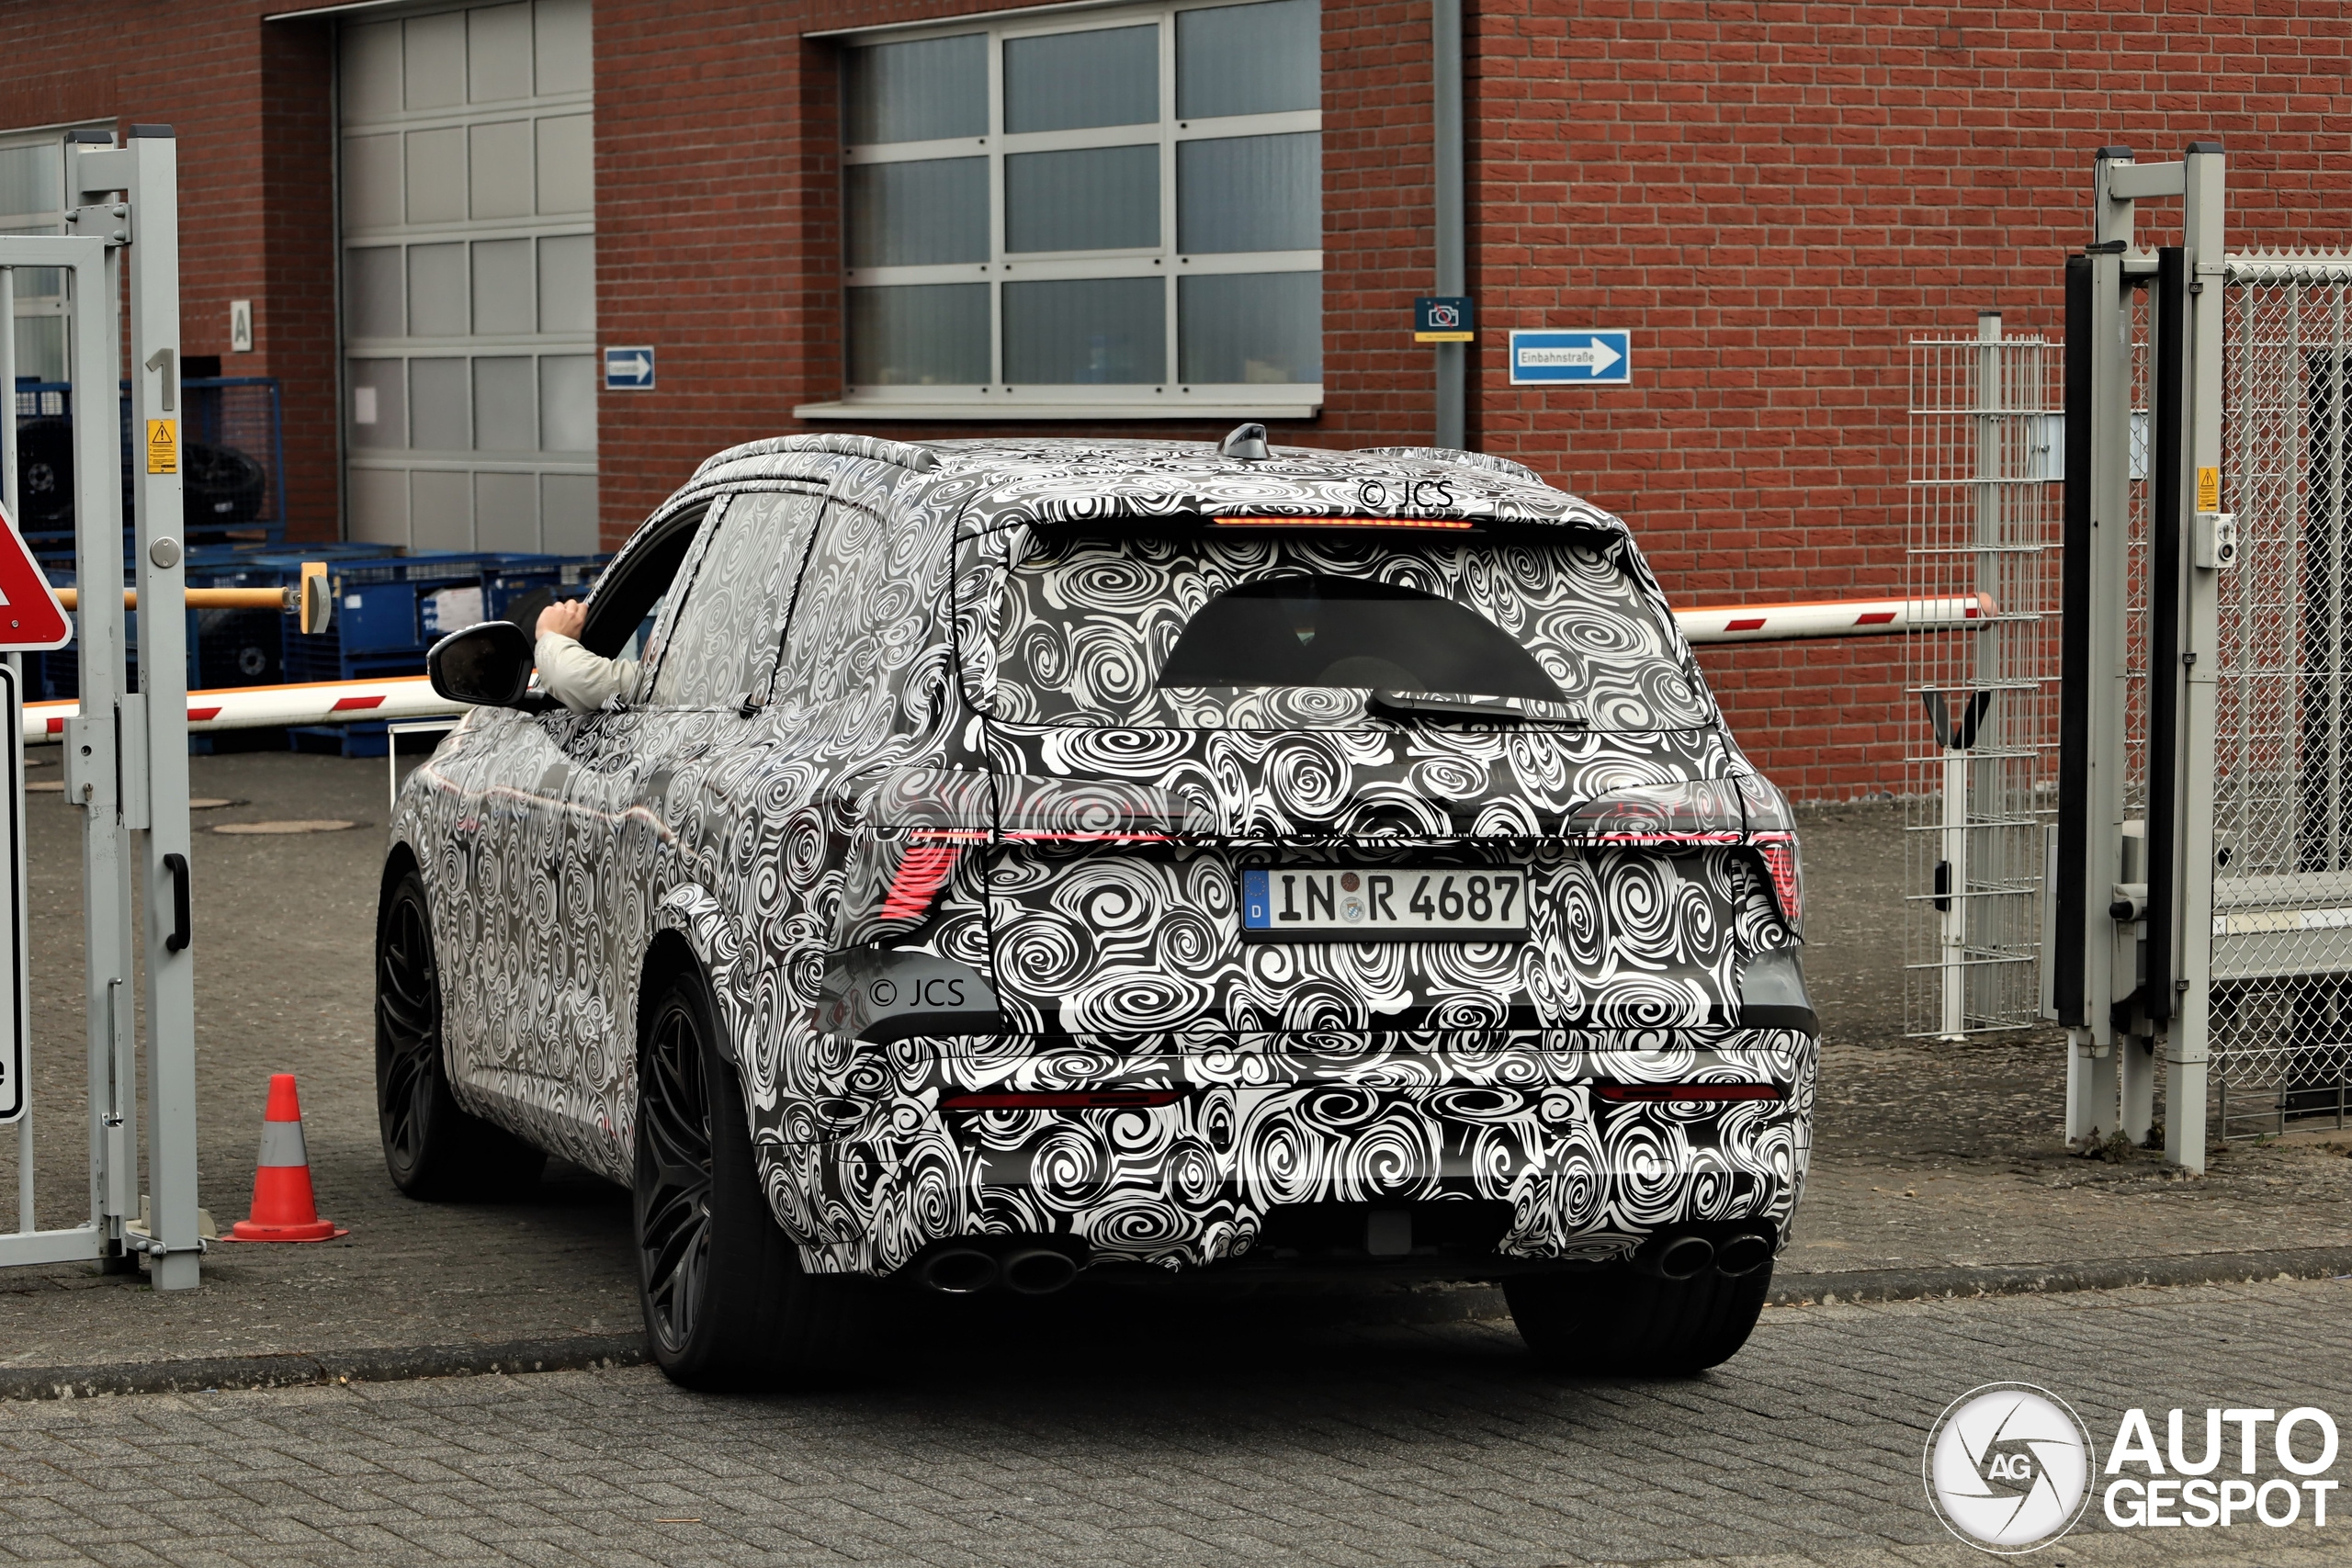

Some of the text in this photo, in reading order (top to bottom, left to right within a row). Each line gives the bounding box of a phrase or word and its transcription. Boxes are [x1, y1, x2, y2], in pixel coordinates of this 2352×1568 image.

[235, 309, 248, 343] A
[1521, 351, 1595, 364] Einbahnstraße
[145, 348, 175, 411] 1
[1251, 905, 1261, 918] D
[1279, 874, 1336, 921] IN
[1368, 874, 1397, 921] R
[1409, 875, 1520, 921] 4687
